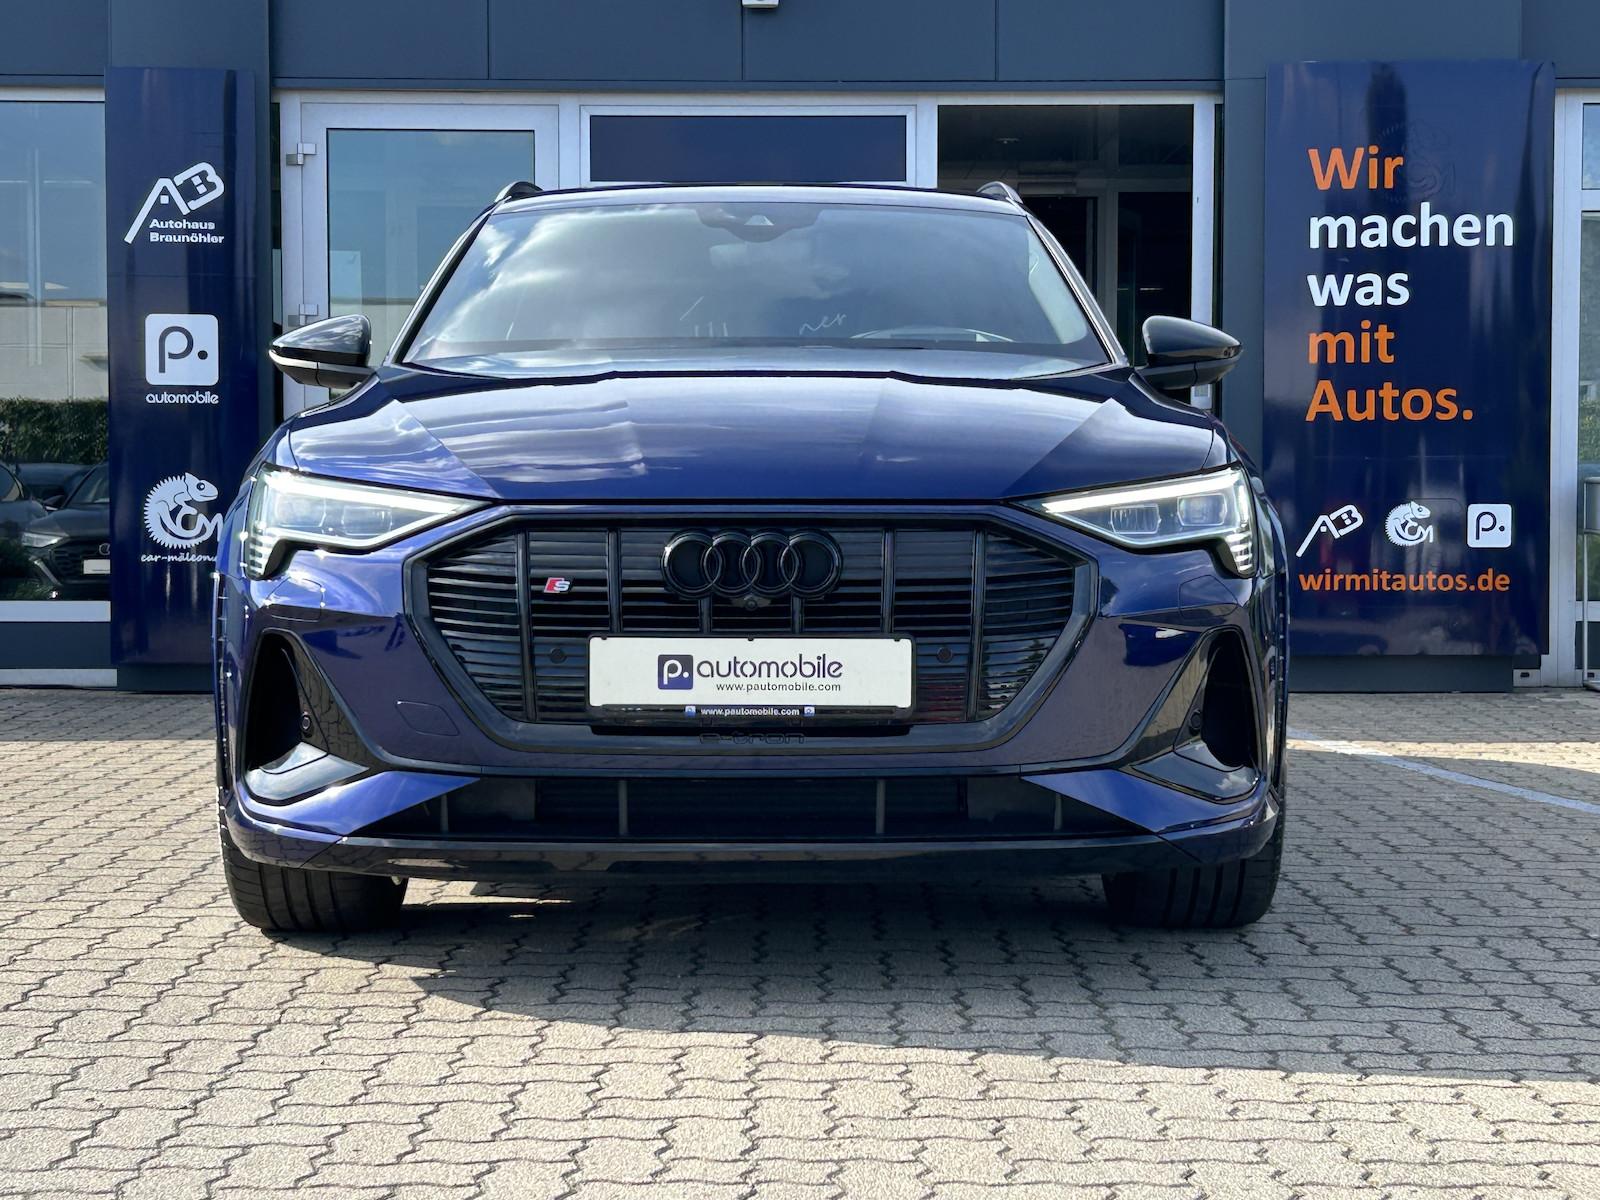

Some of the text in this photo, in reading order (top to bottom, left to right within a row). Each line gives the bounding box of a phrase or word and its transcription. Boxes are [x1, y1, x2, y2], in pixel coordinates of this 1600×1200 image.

[1308, 145, 1404, 190] Wir
[149, 218, 216, 230] Autohaus
[1309, 202, 1514, 249] machen
[149, 232, 225, 244] Braunöhler
[1307, 272, 1410, 307] was
[1308, 320, 1395, 364] mit
[145, 390, 219, 405] automobile
[1305, 379, 1474, 422] Autos.
[1298, 568, 1511, 592] wirmitautos.de
[696, 653, 844, 679] automobile
[716, 683, 841, 693] www.pautomobile.com
[700, 707, 800, 716] www.pautomobile.com
